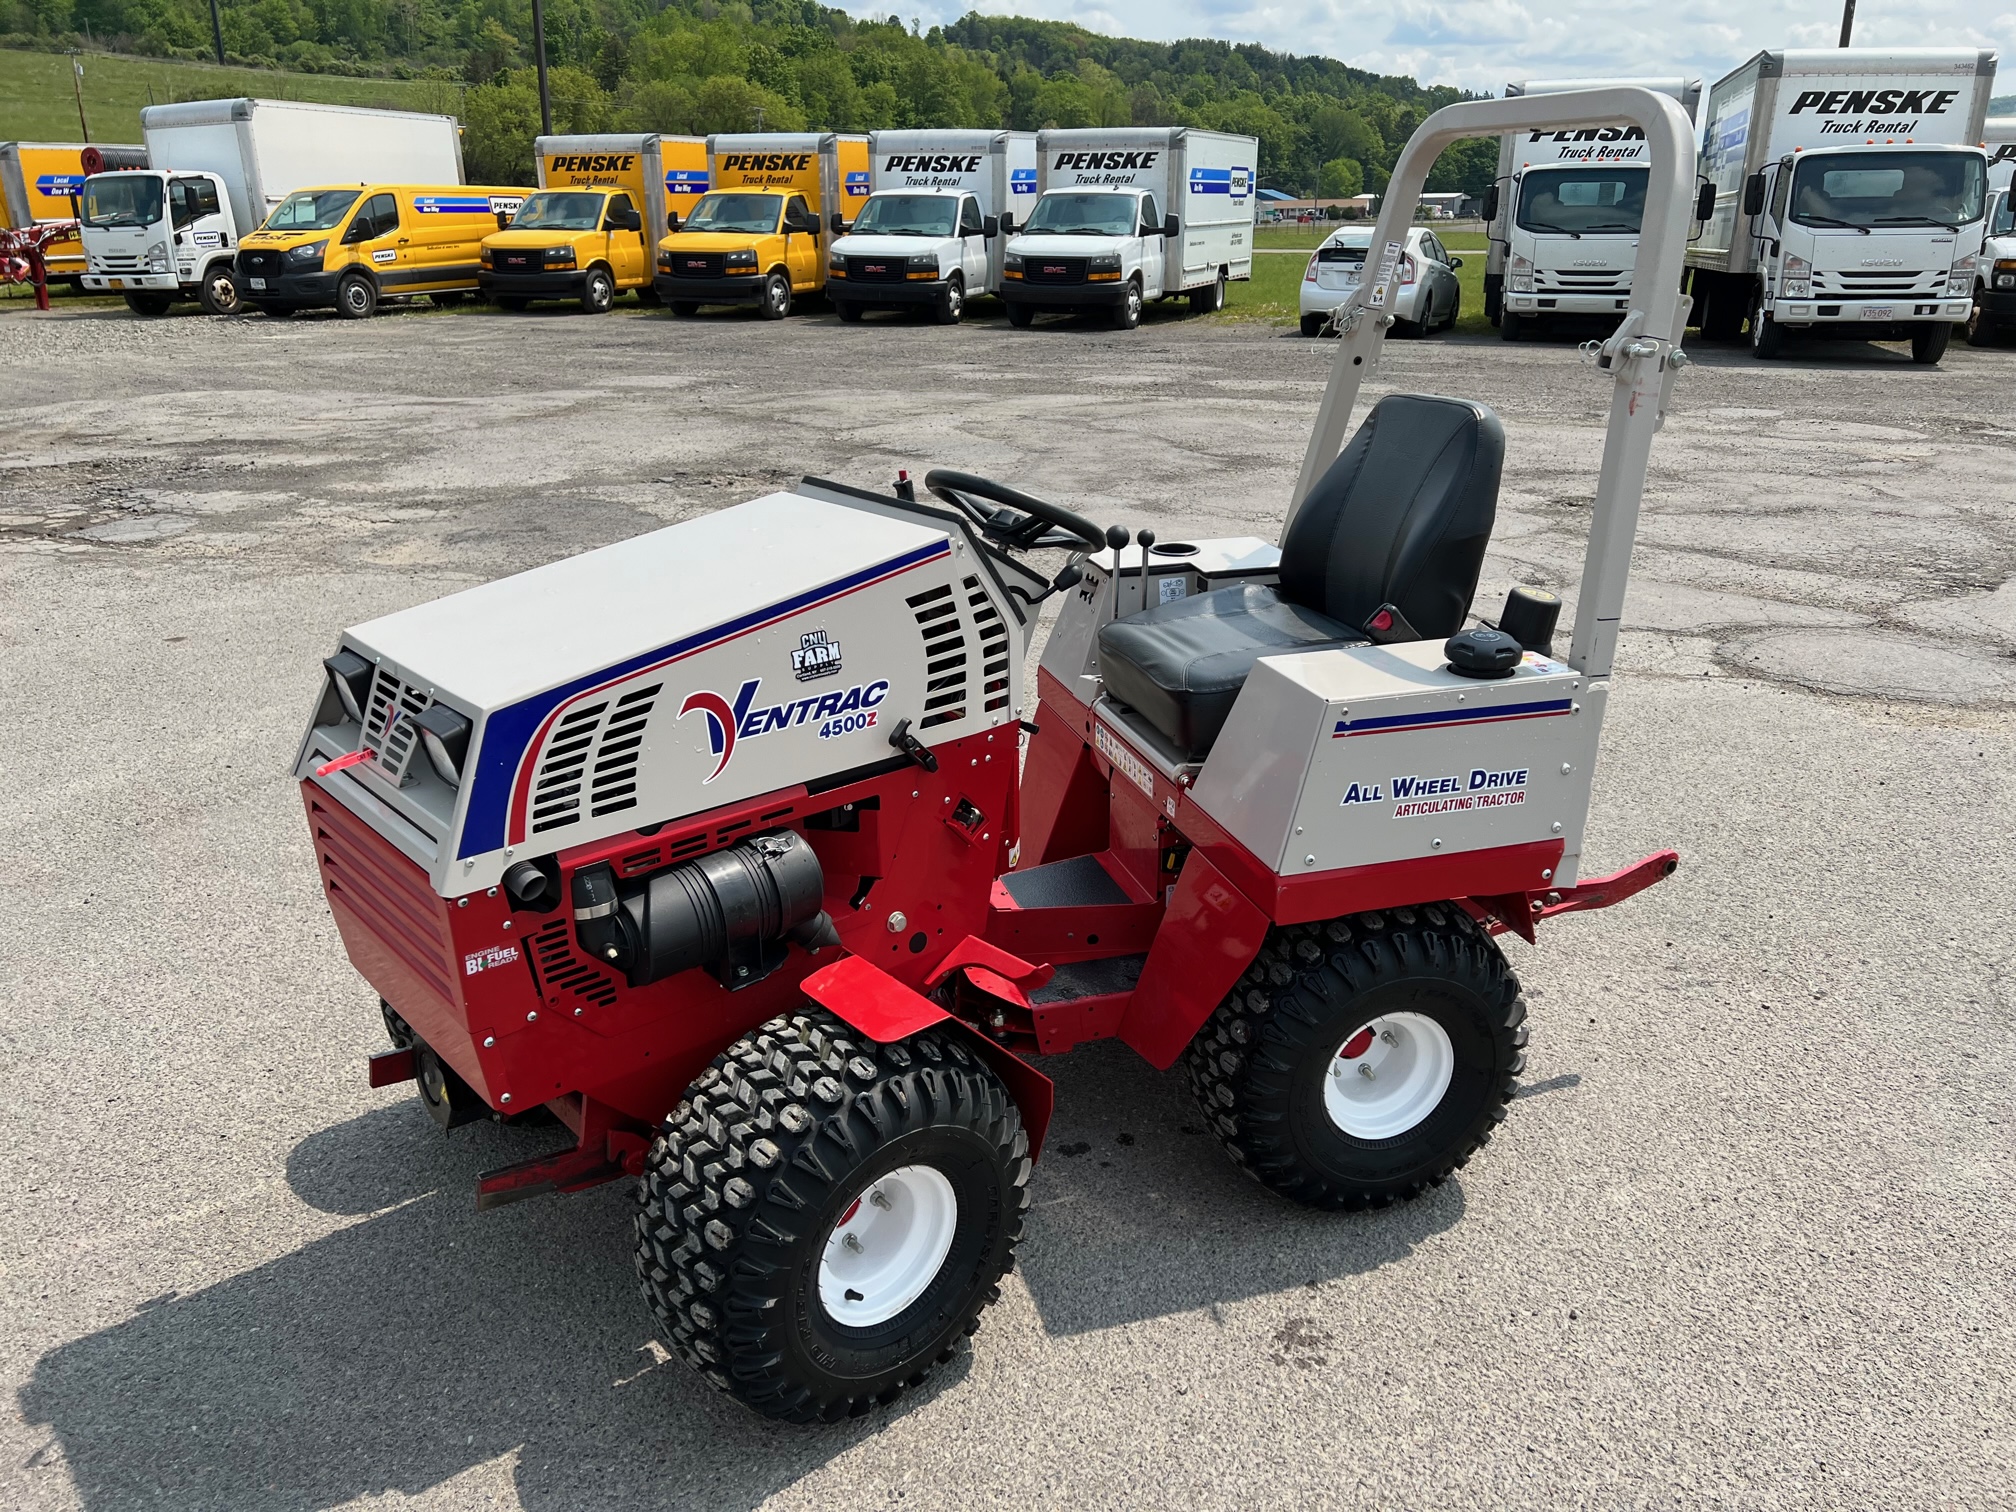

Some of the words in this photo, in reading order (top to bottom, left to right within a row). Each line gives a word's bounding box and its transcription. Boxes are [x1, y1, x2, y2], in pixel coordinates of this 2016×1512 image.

[1788, 89, 1960, 115] PENSKE
[1529, 126, 1648, 143] PENSK
[1820, 120, 1864, 134] Truck
[1864, 120, 1919, 134] Rental
[1558, 146, 1595, 159] Truck
[1596, 145, 1644, 159] Rental
[551, 155, 636, 172] PENSKE
[723, 155, 812, 171] PENSKE
[884, 155, 983, 173] PENSKE
[1053, 151, 1160, 170] PENSKE
[53, 176, 70, 184] Local
[570, 175, 591, 185] Truck
[592, 175, 619, 185] Rental
[742, 174, 765, 184] Truck
[766, 174, 794, 184] Rental
[905, 176, 928, 186] Truck
[930, 176, 962, 186] Rental
[1075, 174, 1102, 184] Truck
[1102, 173, 1136, 184] Rental
[864, 265, 887, 273] GMC
[1043, 266, 1067, 274] GMC
[1573, 259, 1608, 267] ISUZU
[1860, 258, 1904, 268] ISUZU
[1877, 309, 1892, 317] 092
[791, 642, 841, 669] FARM
[678, 679, 889, 783] VENTRAC
[819, 711, 877, 739] 4500Z
[1342, 783, 1383, 804] ALL
[1392, 777, 1461, 798] WHEEL
[1469, 769, 1528, 790] DRIVE
[1395, 797, 1472, 817] ARTICULATING
[1476, 791, 1525, 808] TRACTOR
[465, 946, 500, 961] ENGINE
[465, 957, 484, 976] BI
[486, 947, 519, 963] FUEL
[488, 954, 519, 969] READY
